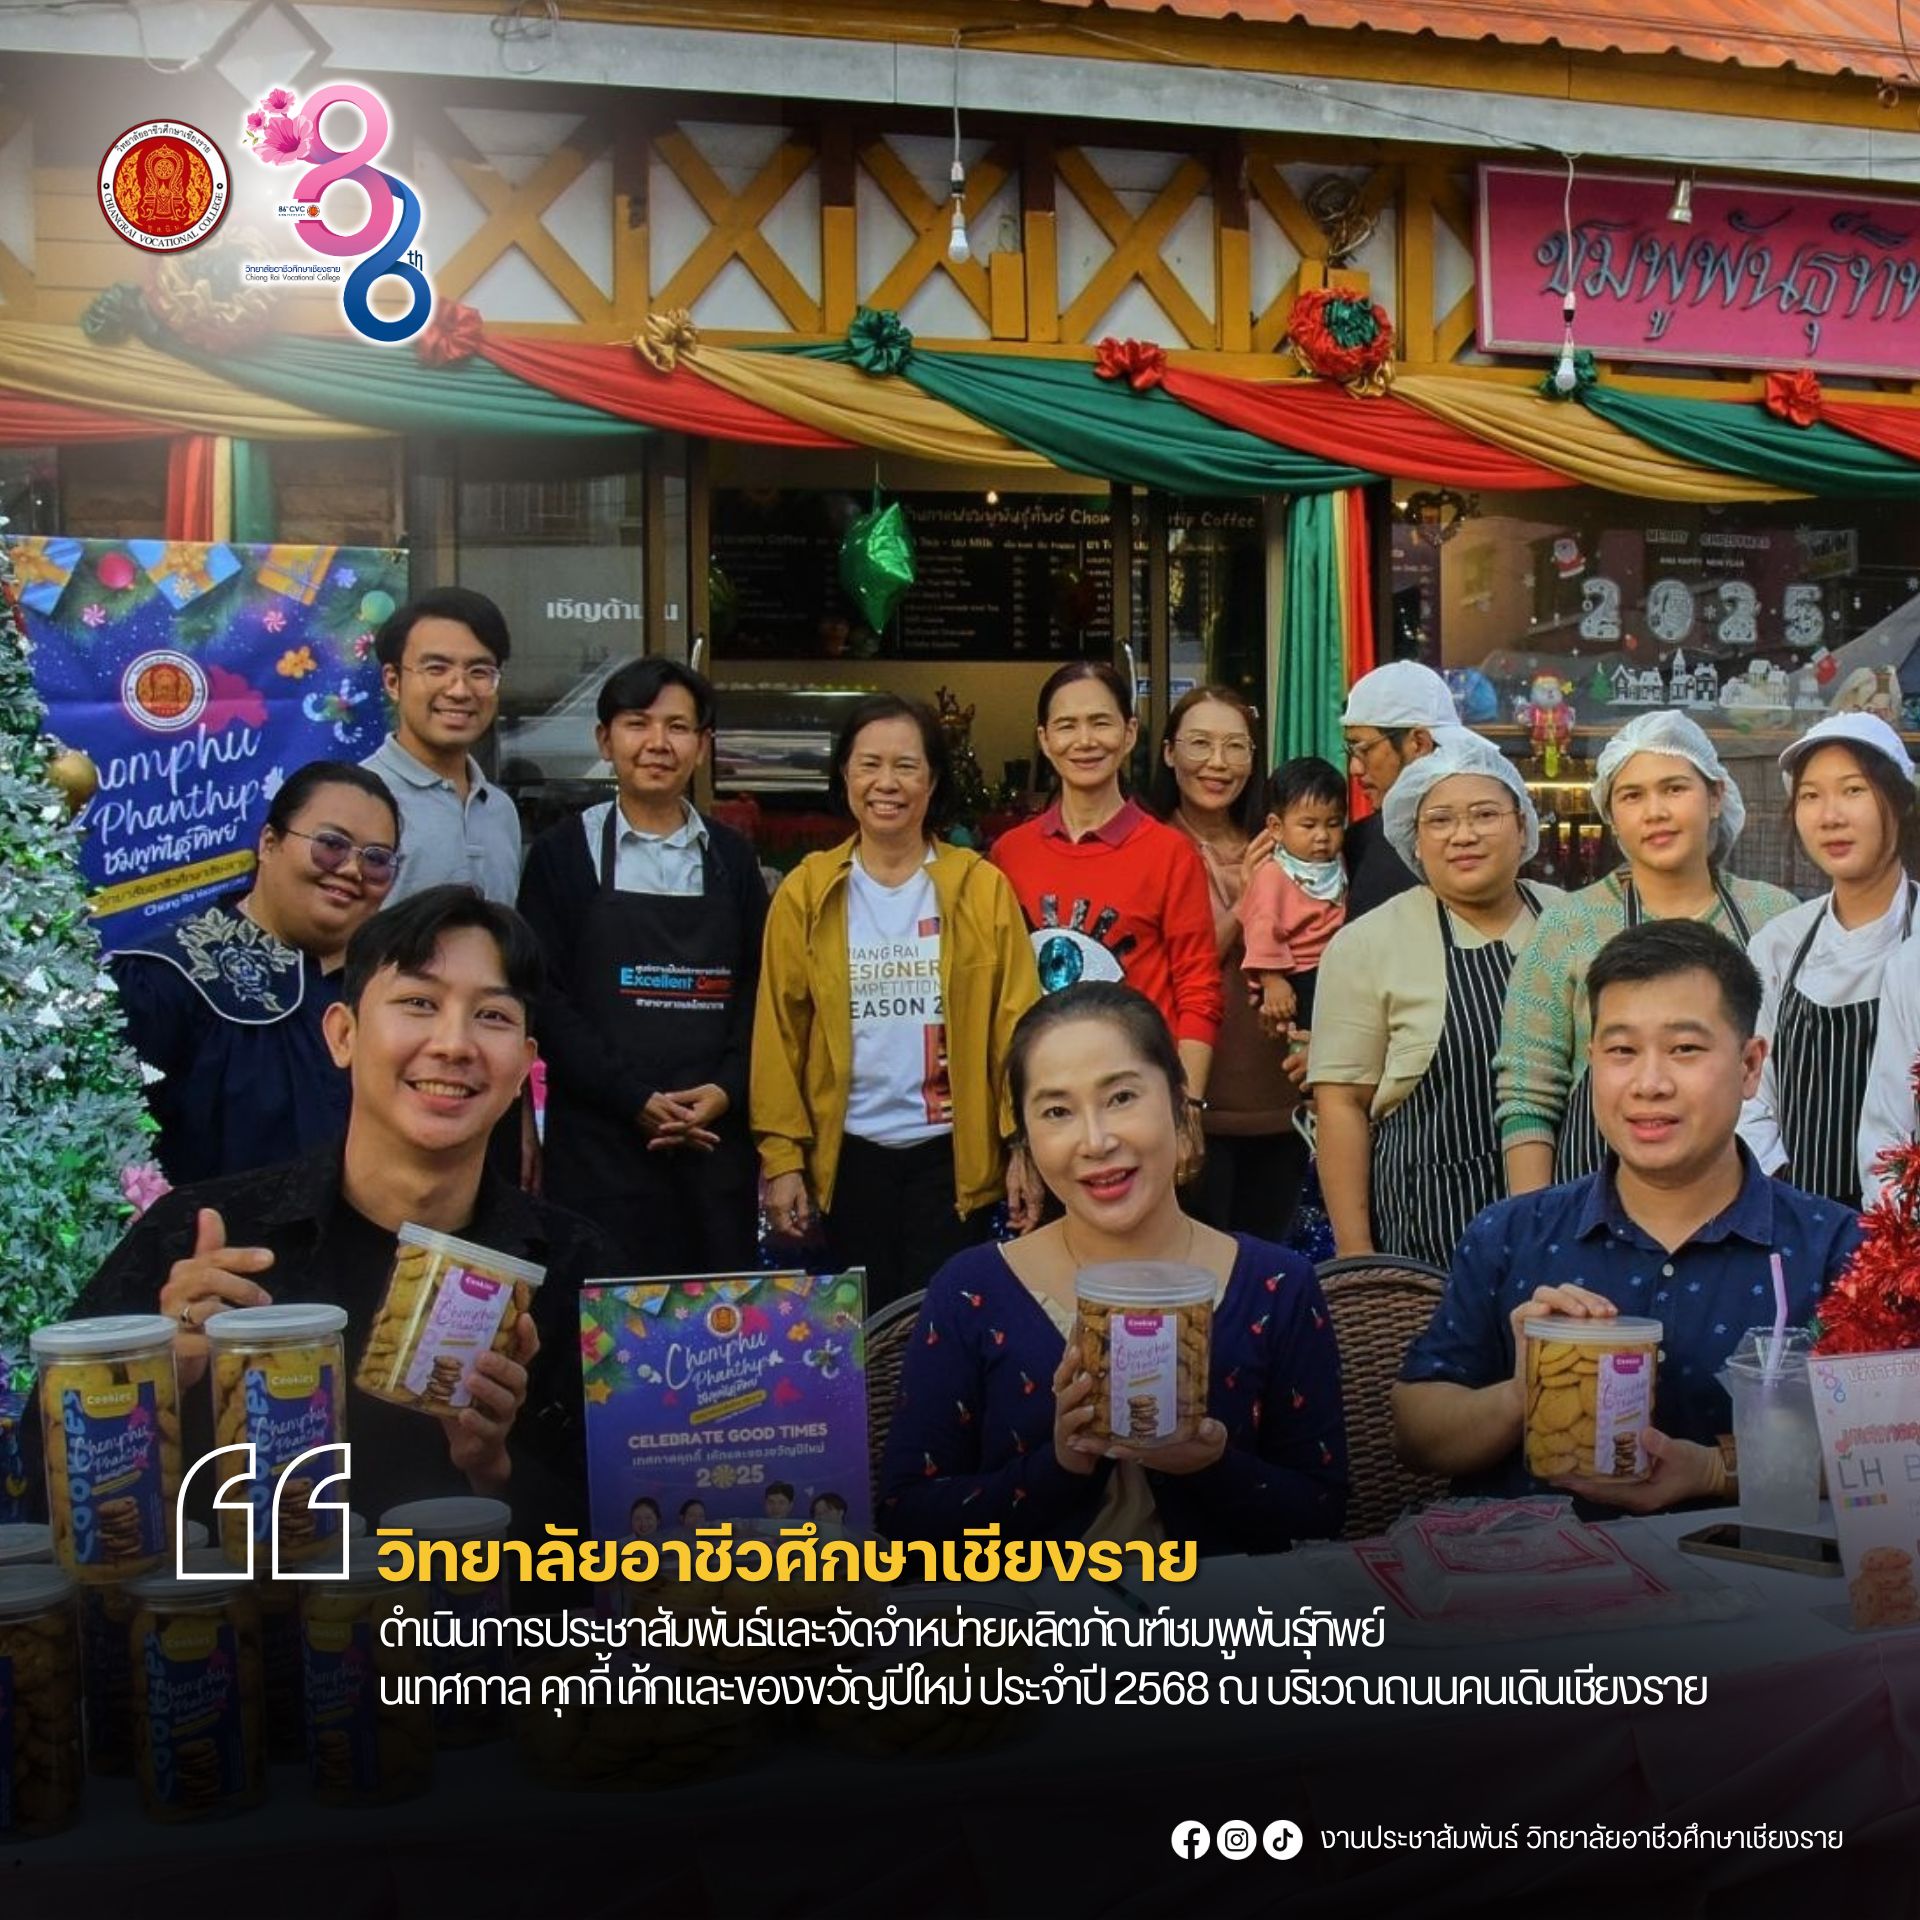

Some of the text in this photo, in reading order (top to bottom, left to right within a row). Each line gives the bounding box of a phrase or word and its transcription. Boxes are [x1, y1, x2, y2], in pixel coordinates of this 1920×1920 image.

[1201, 512, 1256, 528] Coffee
[96, 722, 263, 796] omphu
[92, 779, 260, 845] Phanthip
[620, 967, 694, 990] Excellent
[848, 959, 941, 981] ESIGNER
[849, 997, 925, 1020] EASON
[665, 1330, 767, 1391] Chomphu
[272, 1373, 314, 1386] Cookies
[87, 1390, 133, 1406] Cookies
[628, 1422, 828, 1450] CELEBRATE GOOD TIMES
